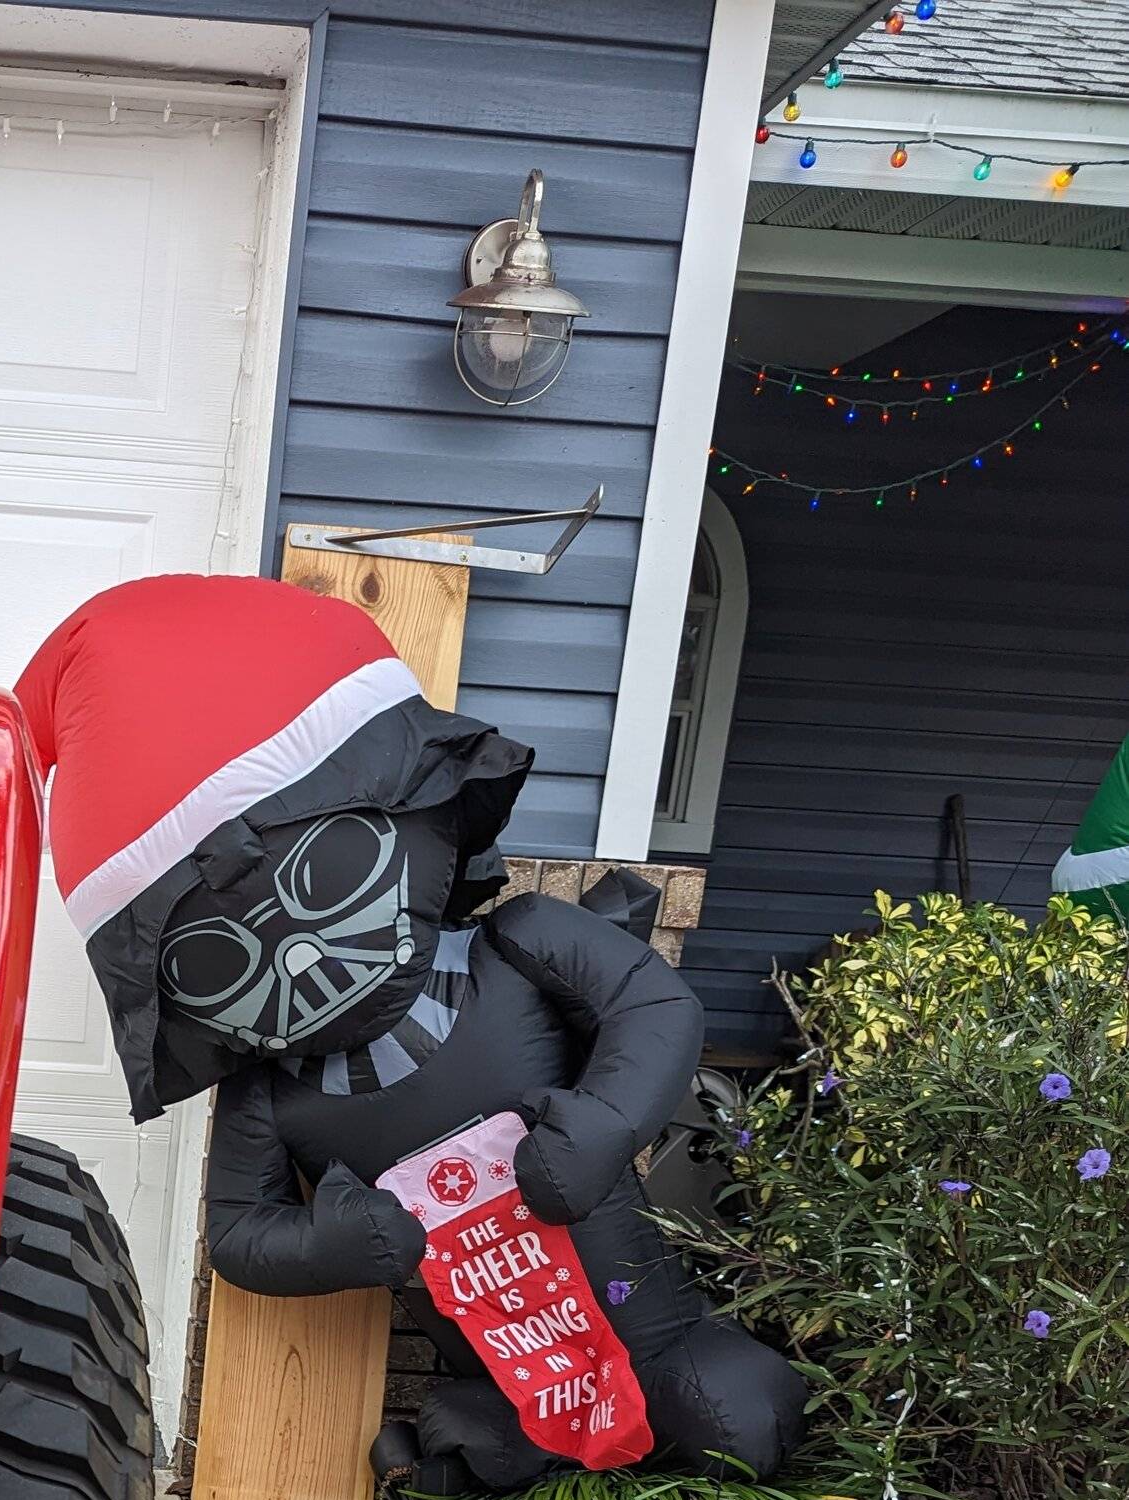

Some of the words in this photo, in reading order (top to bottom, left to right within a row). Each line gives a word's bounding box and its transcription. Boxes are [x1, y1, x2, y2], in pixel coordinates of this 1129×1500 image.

[456, 1216, 504, 1250] THE
[450, 1230, 551, 1302] CHEER
[499, 1287, 525, 1313] IS
[483, 1297, 590, 1359] STRONG
[544, 1351, 574, 1373] IN
[534, 1372, 598, 1419] THIS
